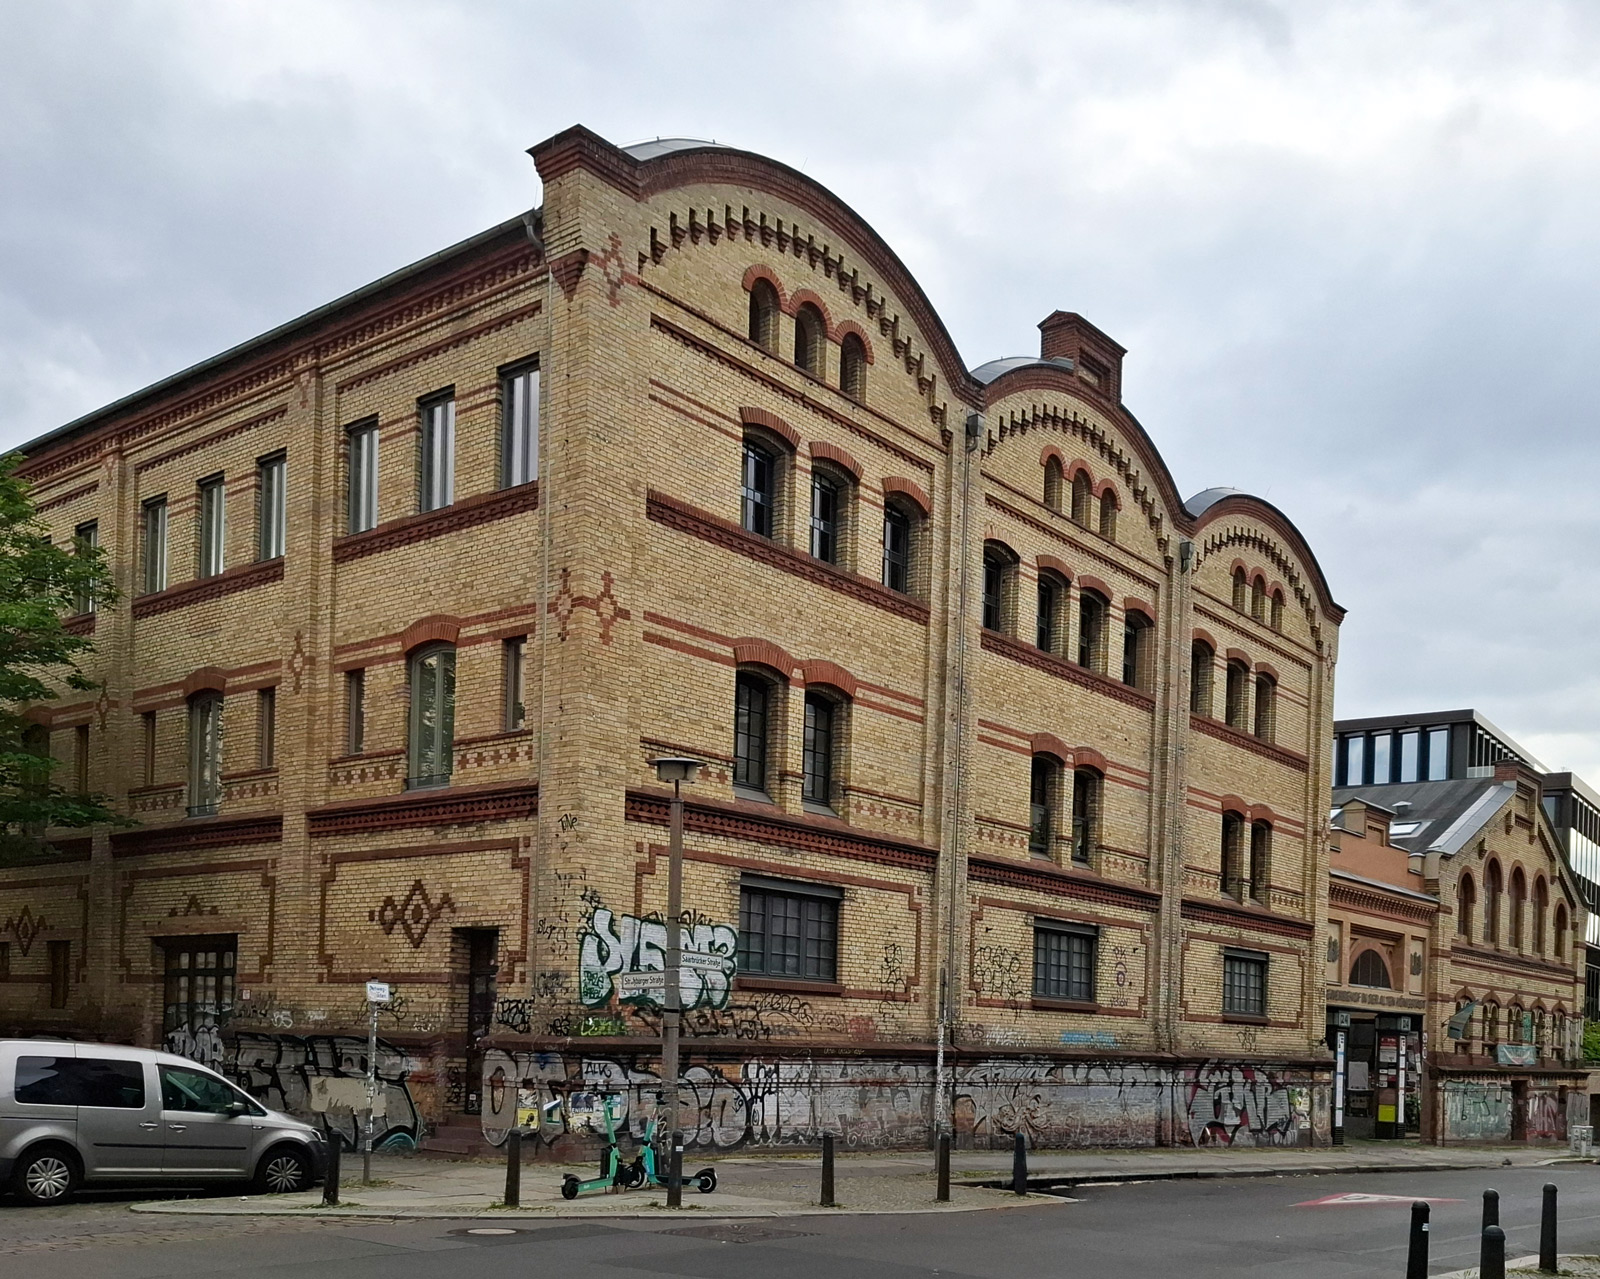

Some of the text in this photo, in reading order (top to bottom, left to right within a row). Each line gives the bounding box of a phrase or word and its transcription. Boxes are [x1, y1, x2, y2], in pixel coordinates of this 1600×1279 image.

[682, 954, 721, 969] Saarbrücker Straße
[649, 975, 664, 985] Straße
[1340, 1014, 1349, 1024] 24
